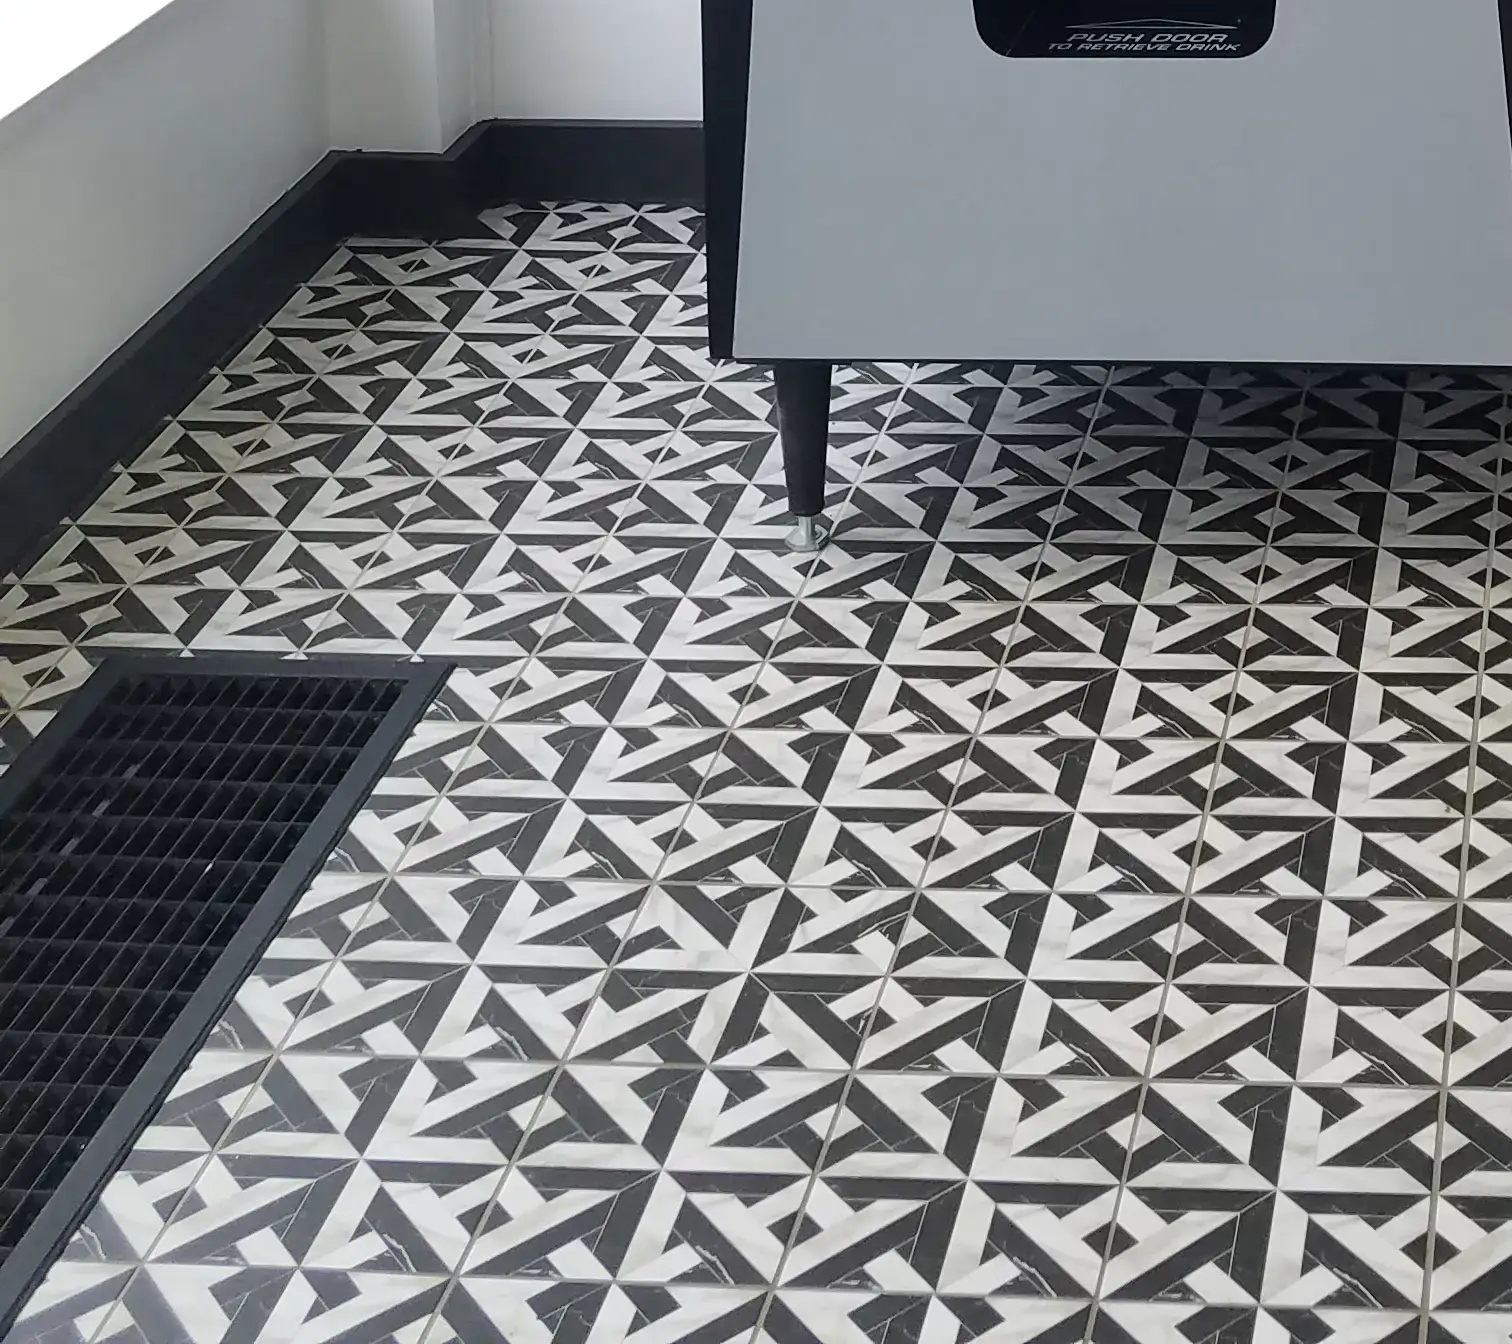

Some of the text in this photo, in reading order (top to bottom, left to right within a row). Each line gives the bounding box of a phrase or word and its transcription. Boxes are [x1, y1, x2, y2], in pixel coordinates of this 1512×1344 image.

[1067, 33, 1228, 42] PUSH DOOR
[1077, 43, 1172, 51] RETRIEVE
[1175, 43, 1241, 51] DRINK
